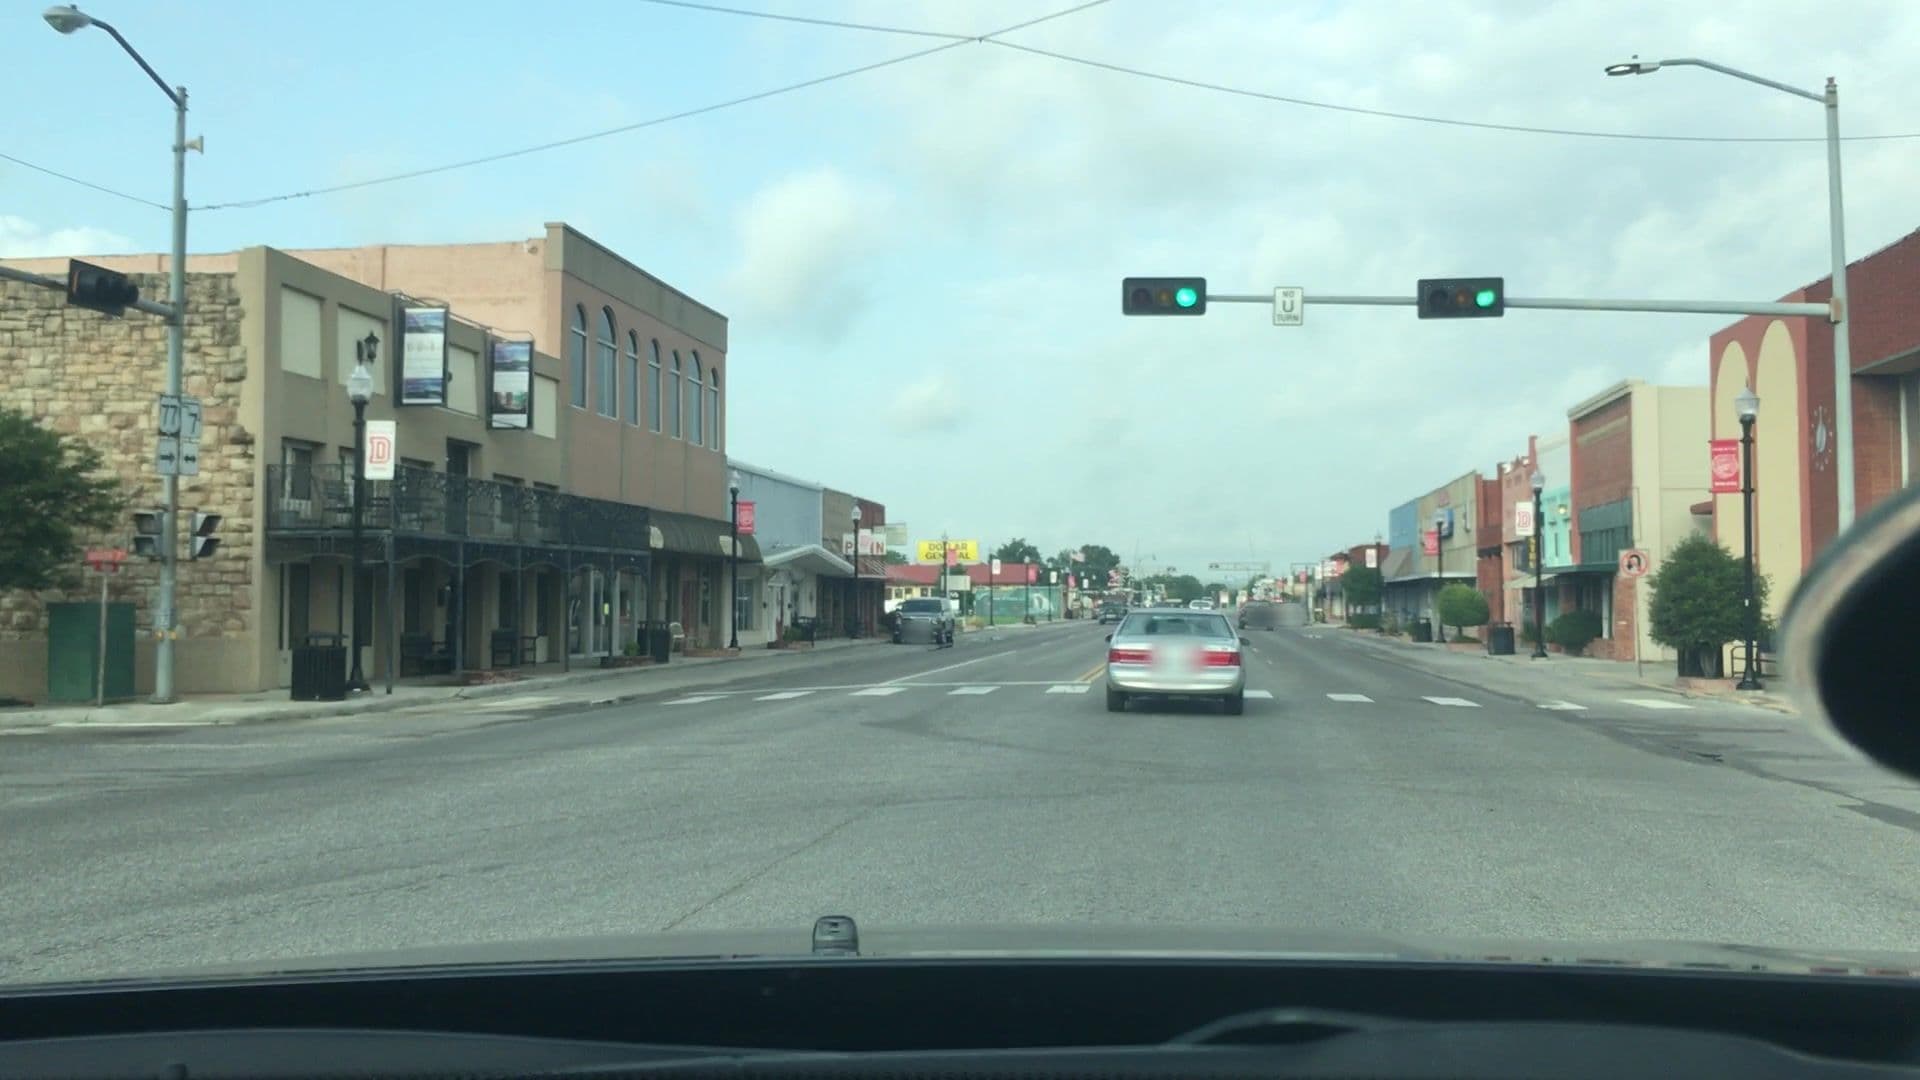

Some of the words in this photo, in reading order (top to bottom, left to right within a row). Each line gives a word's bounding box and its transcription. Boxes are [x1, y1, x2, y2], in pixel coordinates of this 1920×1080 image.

[1282, 290, 1295, 298] NO
[1282, 300, 1295, 313] U
[1276, 314, 1299, 322] TURN
[161, 404, 178, 426] 77
[369, 436, 391, 464] D
[1518, 511, 1532, 528] D
[928, 543, 968, 551] DOLAR
